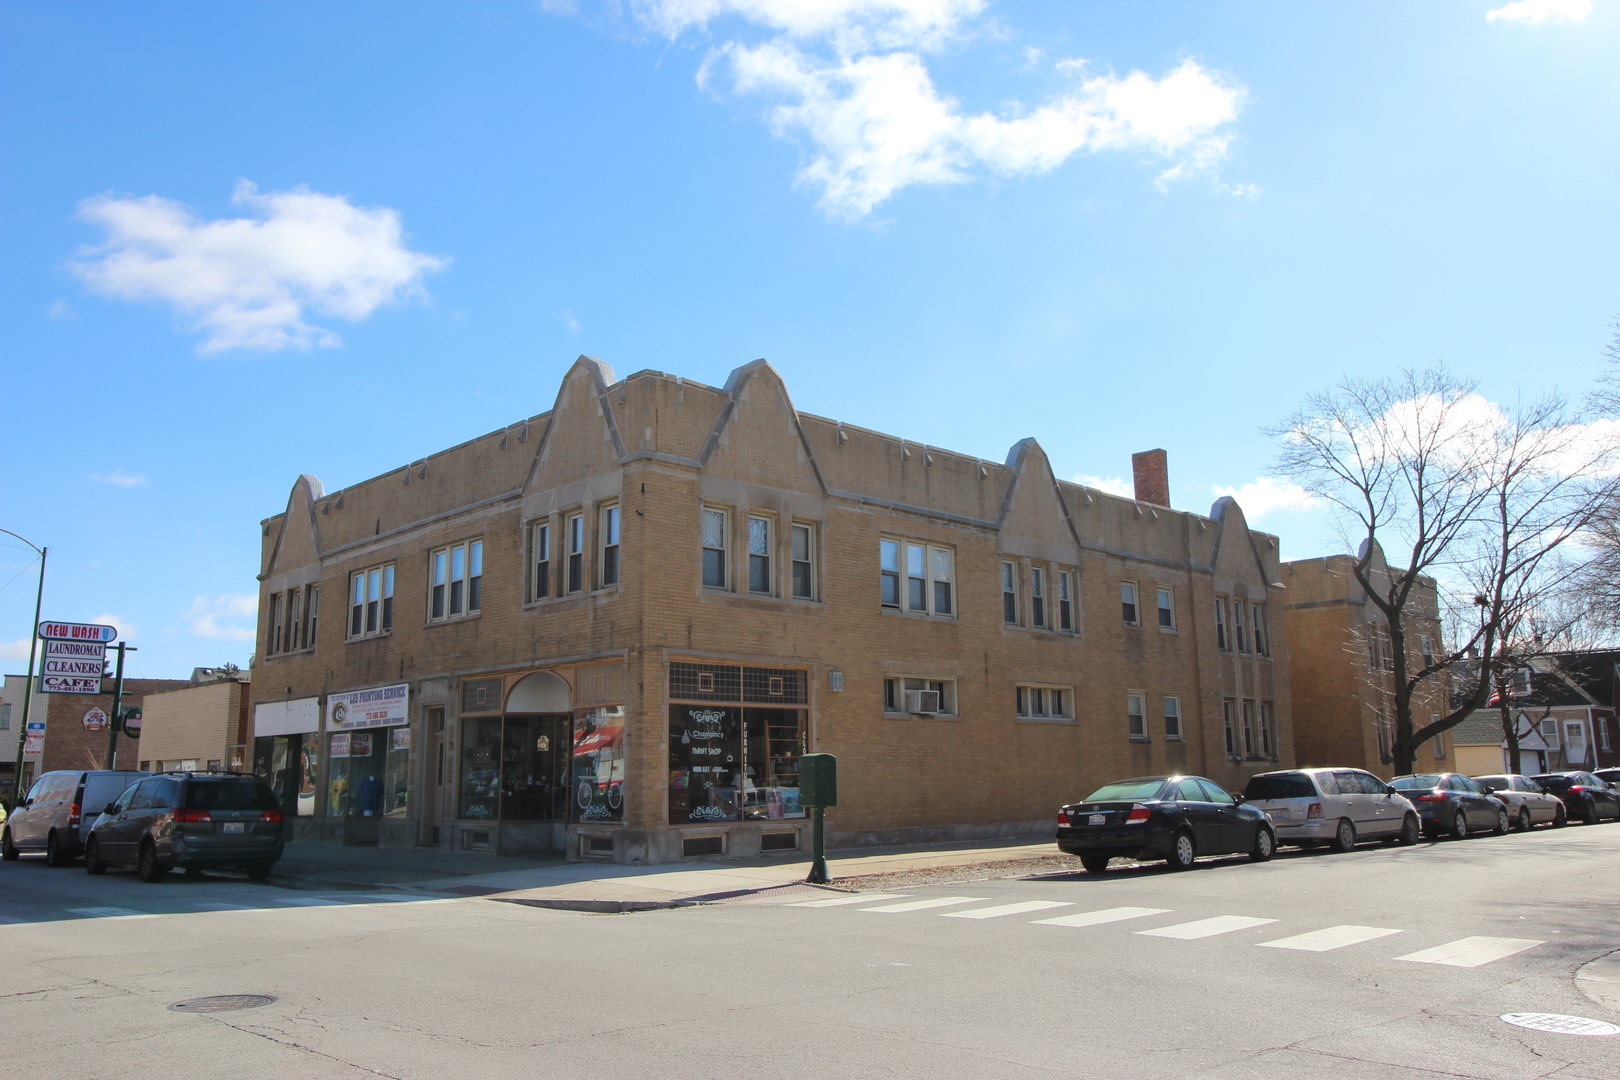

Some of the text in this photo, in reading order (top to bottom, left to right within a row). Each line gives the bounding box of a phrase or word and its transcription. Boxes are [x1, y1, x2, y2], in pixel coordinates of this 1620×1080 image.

[46, 624, 109, 640] NEW WASH U
[48, 642, 103, 656] LAUNDROMAT
[46, 661, 101, 674] CLEANERS
[47, 685, 95, 693] 773-481-1890
[359, 689, 384, 703] PRINTING
[384, 686, 406, 700] SERVICE
[692, 730, 725, 739] Chaplaincy
